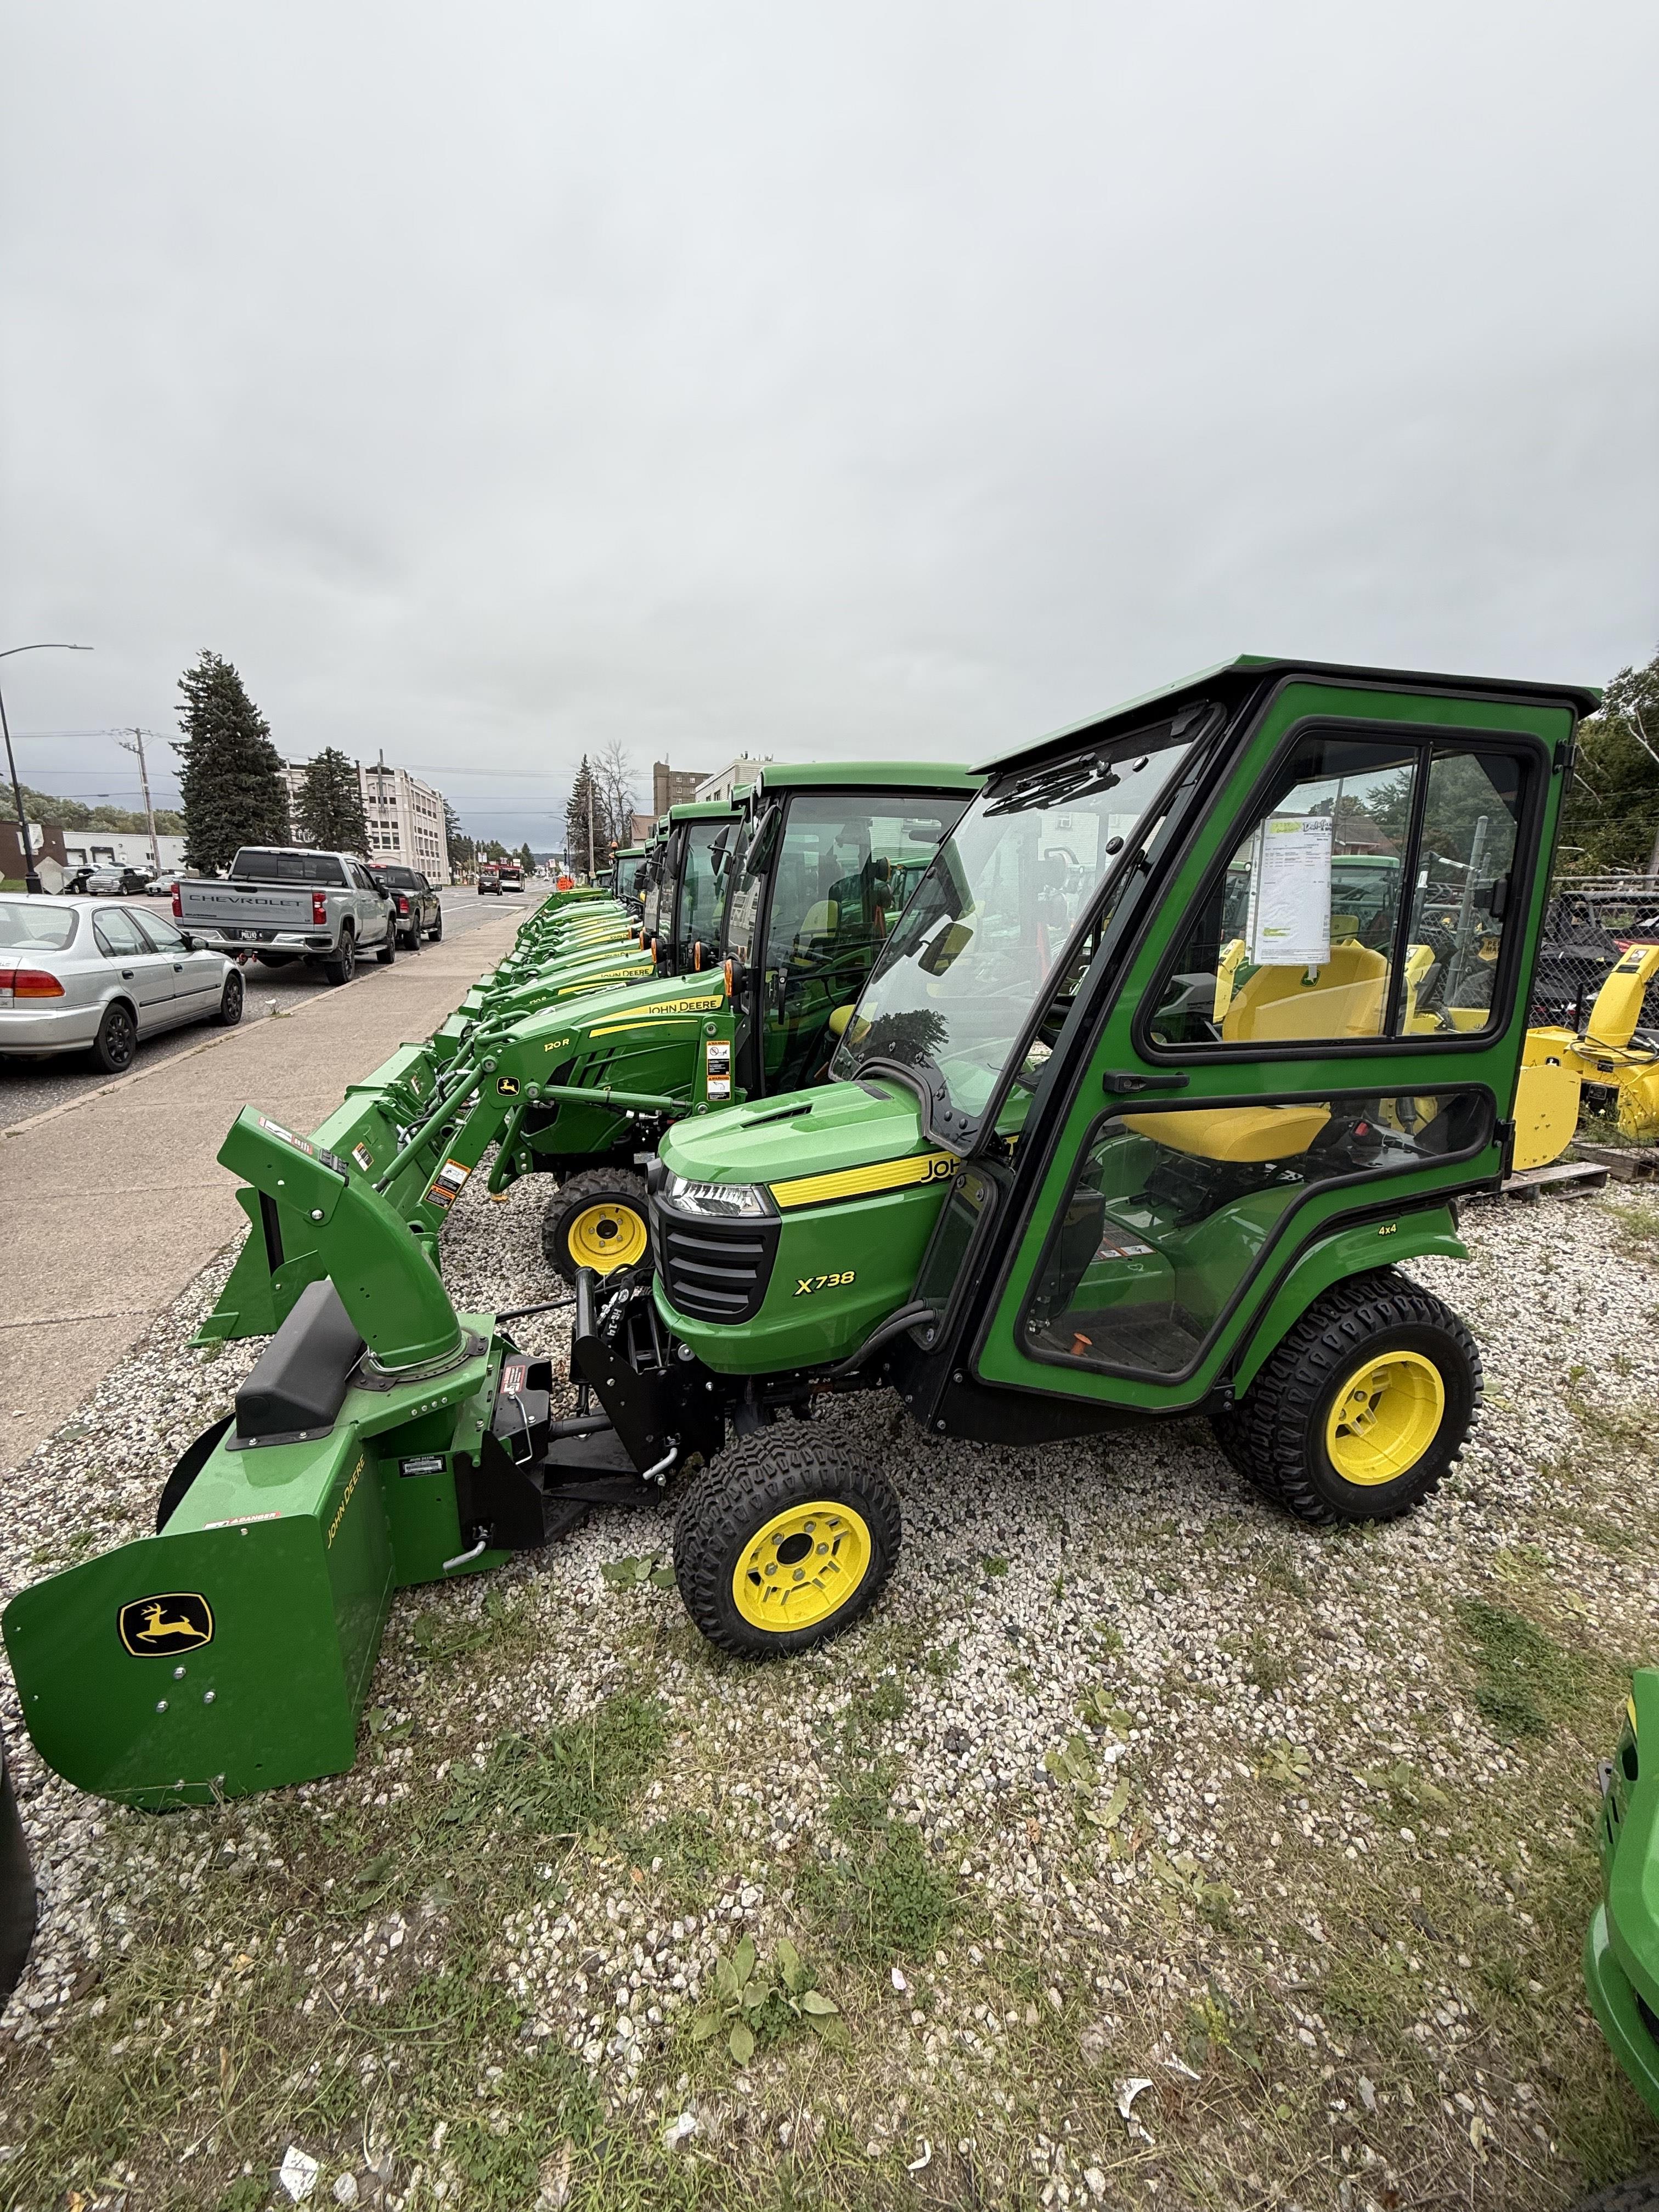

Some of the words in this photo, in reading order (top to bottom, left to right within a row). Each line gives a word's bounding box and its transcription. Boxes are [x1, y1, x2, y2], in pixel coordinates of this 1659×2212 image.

[189, 895, 303, 907] CHEVROLET
[680, 1000, 716, 1011] DEERE
[544, 1041, 561, 1052] 120
[562, 1038, 569, 1046] R
[921, 1158, 960, 1181] JOH
[1378, 1223, 1397, 1235] 4x4
[793, 1270, 855, 1296] X738
[607, 1308, 622, 1336] HG-14
[328, 1500, 345, 1549] JOHN
[344, 1453, 365, 1505] DEERE
[239, 1513, 276, 1523] DANGER
